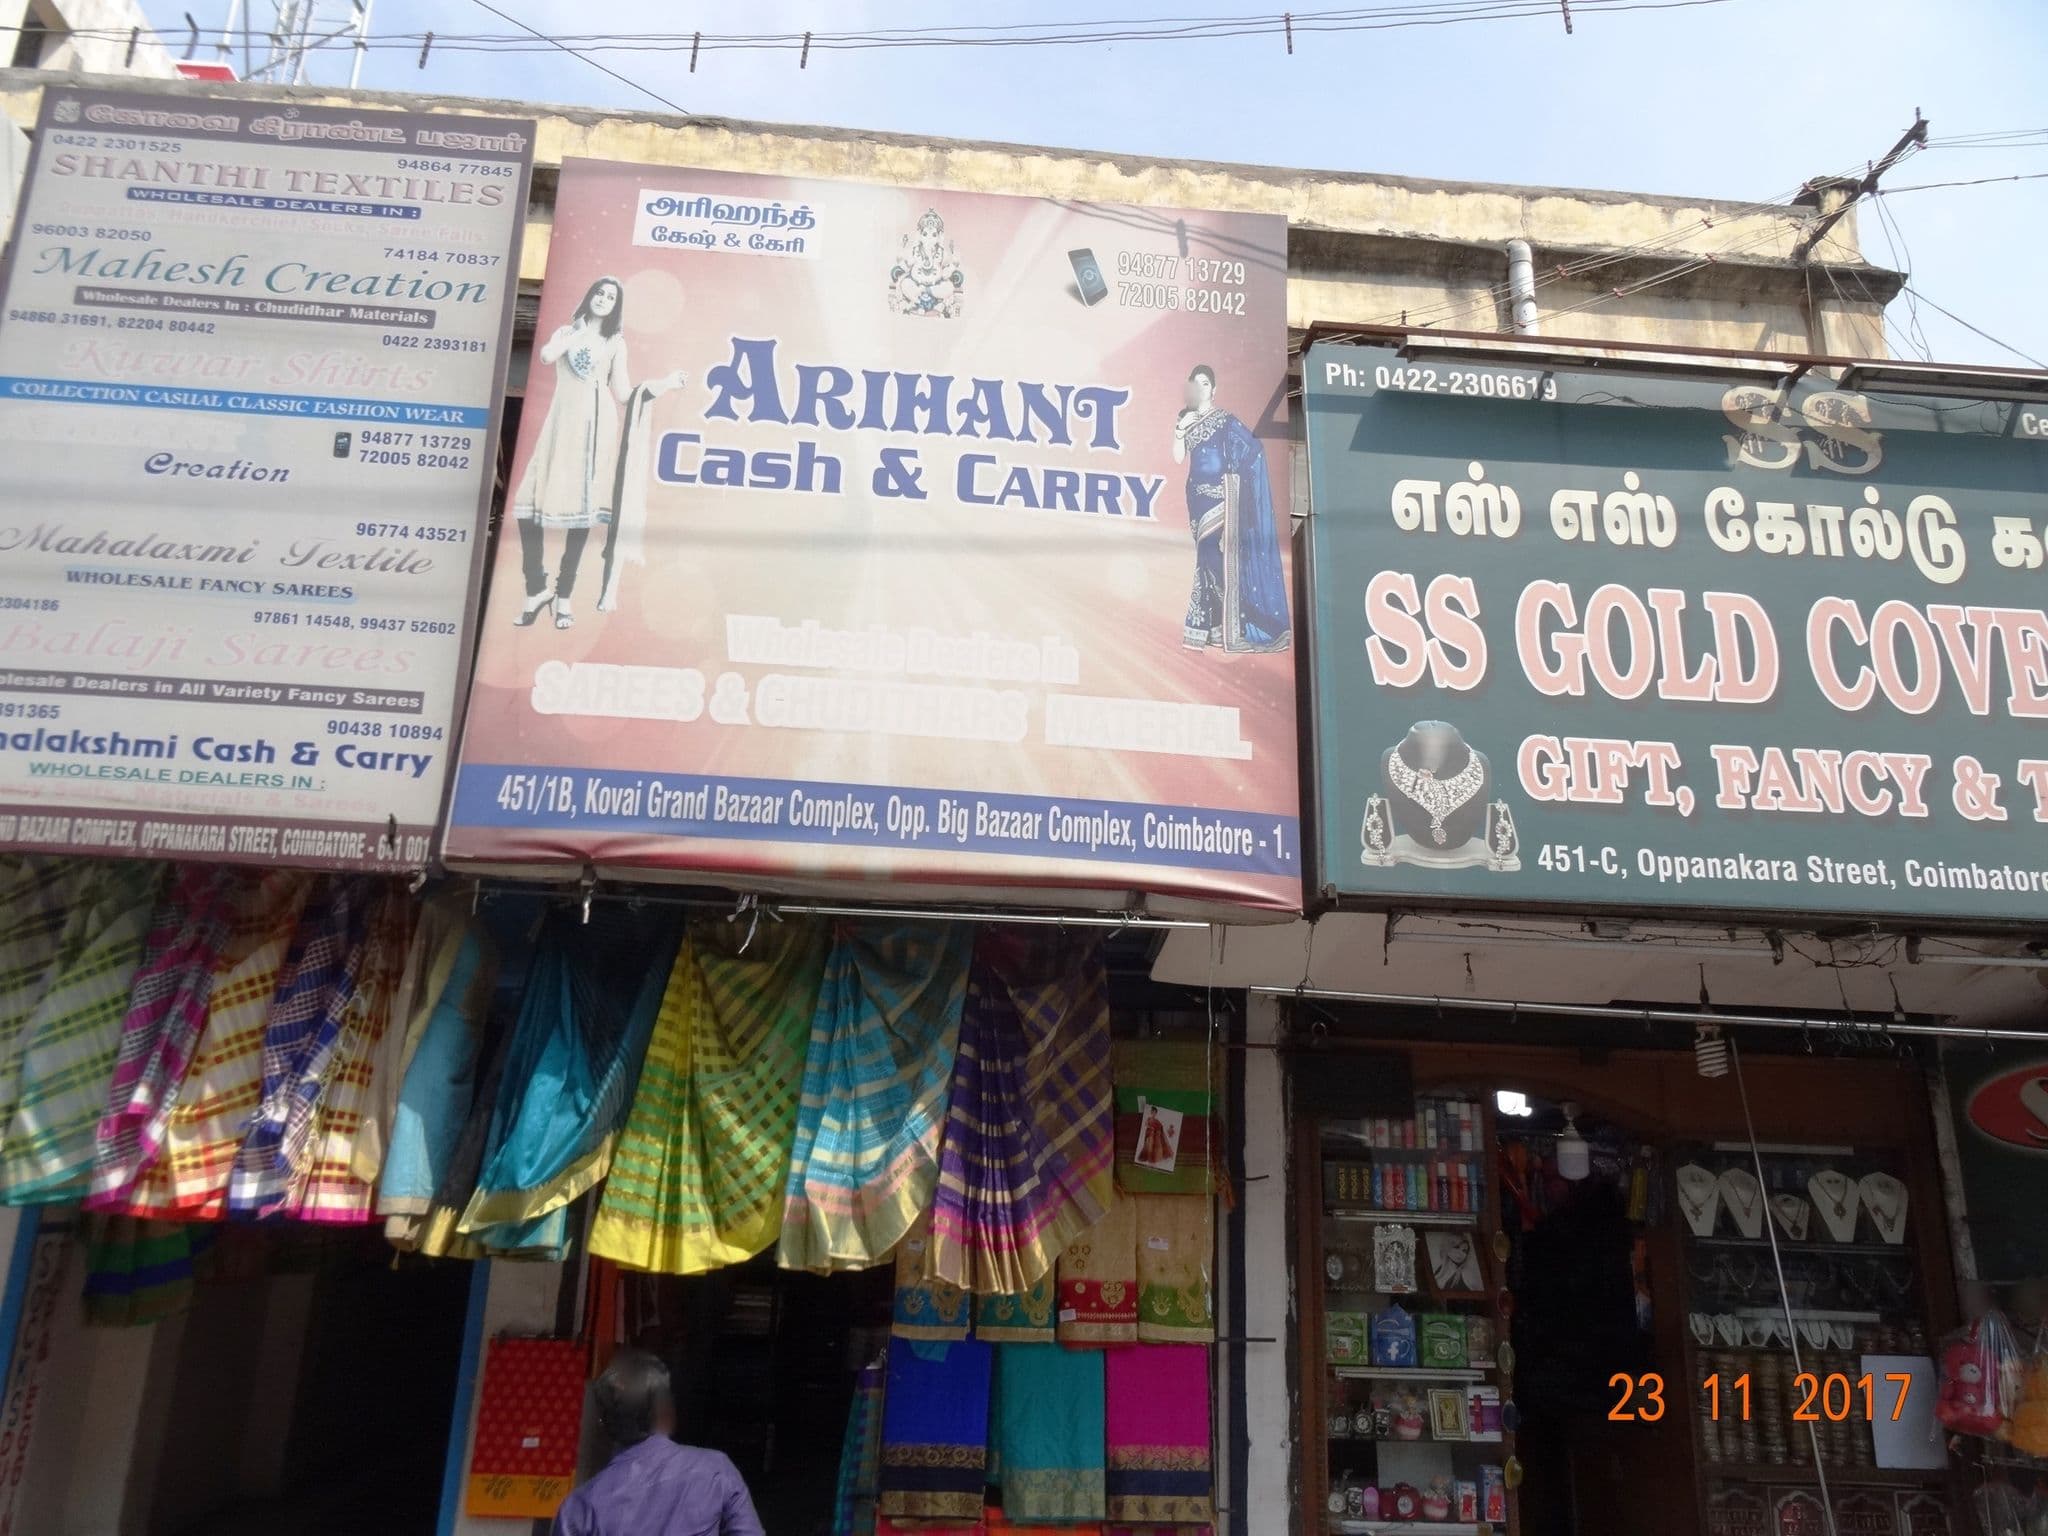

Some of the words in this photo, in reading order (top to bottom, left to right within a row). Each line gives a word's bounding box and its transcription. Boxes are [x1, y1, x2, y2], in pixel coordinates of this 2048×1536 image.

[52, 134, 97, 148] 0422
[104, 137, 182, 153] 2301525
[51, 153, 271, 190] SHANTHI
[285, 169, 505, 207] TEXTILES
[397, 158, 452, 173] 94864
[459, 163, 512, 177] 77845
[132, 189, 264, 207] WHOLESALE
[274, 199, 373, 215] DEALERS
[382, 206, 403, 217] IN
[32, 223, 89, 237] 96003
[96, 227, 152, 242] 82050
[723, 233, 740, 247] &
[384, 248, 439, 262] 74184
[446, 252, 500, 266] 70837
[1118, 251, 1180, 280] 94877
[1185, 256, 1246, 285] 13729
[32, 247, 249, 287] Mahesh
[266, 263, 487, 304] Creation
[82, 290, 158, 306] Wholesale
[163, 294, 220, 310] Dealers
[224, 299, 239, 311] In
[255, 302, 344, 318] Chudidhar
[350, 307, 429, 324] Materials
[1118, 281, 1180, 310] 72005
[1185, 287, 1246, 316] 82042
[169, 320, 215, 335] 80442
[382, 335, 419, 349] 0422
[424, 337, 487, 353] 2393181
[269, 350, 434, 392] Shirts
[1325, 362, 1365, 388] Ph:
[1375, 365, 1558, 401] 0422-2306619
[11, 382, 140, 401] COLLECTION
[144, 389, 224, 408] CASUAL
[227, 396, 309, 413] CLASSIC
[312, 401, 400, 419] FASHION
[405, 407, 464, 423] WEAR
[702, 335, 1131, 452] ARIHANT
[361, 430, 413, 446] 94877
[420, 434, 471, 451] 13729
[144, 452, 290, 483] Creation
[359, 449, 411, 466] 72005
[416, 454, 469, 470] 82042
[656, 431, 843, 495] Cash
[871, 445, 929, 501] &
[954, 451, 1167, 519] CARRY
[356, 522, 409, 538] 96774
[415, 526, 467, 542] 43521
[1391, 461, 1521, 538] எஸ்
[1550, 470, 1677, 548] எஸ்
[1704, 486, 1966, 585] கோல்டு
[1991, 516, 2048, 569] க
[0, 522, 260, 563] Mahalaxmi
[280, 536, 436, 575] Textile
[66, 571, 193, 590] WHOLESALE
[200, 578, 266, 595] FANCY
[272, 582, 354, 599] SAREES
[254, 611, 298, 625] 97861
[305, 614, 354, 630] 14548,
[360, 617, 406, 632] 99437
[411, 620, 455, 634] 52602
[2, 618, 194, 670] Balaji
[206, 632, 416, 673] Sarees
[1365, 570, 1488, 691] SS
[1515, 579, 1779, 704] GOLD
[1806, 596, 2048, 719] COVE
[72, 676, 148, 693] Dealers
[155, 681, 173, 694] in
[180, 683, 205, 696] All
[212, 684, 281, 702] Variety
[288, 690, 346, 705] Fancy
[353, 692, 420, 708] Sarees
[533, 662, 704, 721] SAREES
[710, 673, 750, 724] &
[327, 720, 381, 737] 90438
[389, 724, 443, 741] 10894
[192, 736, 275, 764] Cash
[290, 741, 320, 766] &
[335, 744, 433, 778] Carry
[29, 761, 172, 782] WHOLESALE
[179, 770, 283, 787] DEALERS
[292, 775, 313, 788] IN
[1517, 734, 1695, 817] GIFT,
[1710, 744, 1932, 817] FANCY
[1952, 754, 2008, 821] &
[497, 774, 577, 819] 451/1B,
[584, 777, 642, 816] Kovai
[648, 781, 707, 820] Grand
[713, 785, 784, 825] Bazaar
[788, 789, 879, 836] Complex,
[886, 794, 930, 841] Opp.
[937, 798, 969, 843] Big
[975, 800, 1042, 840] Bazaar
[1048, 805, 1137, 852] Complex,
[1143, 812, 1253, 857] Coimbatore
[17, 815, 70, 843] BAZAAR
[141, 821, 226, 852] OPPANAKARA
[228, 825, 278, 859] STREET,
[281, 828, 367, 858] COIMBATORE
[1538, 844, 1628, 879] 451-C,
[1637, 848, 1799, 884] Oppanakara
[1806, 855, 1897, 890] Street,
[1905, 859, 2048, 892] Coimbatore
